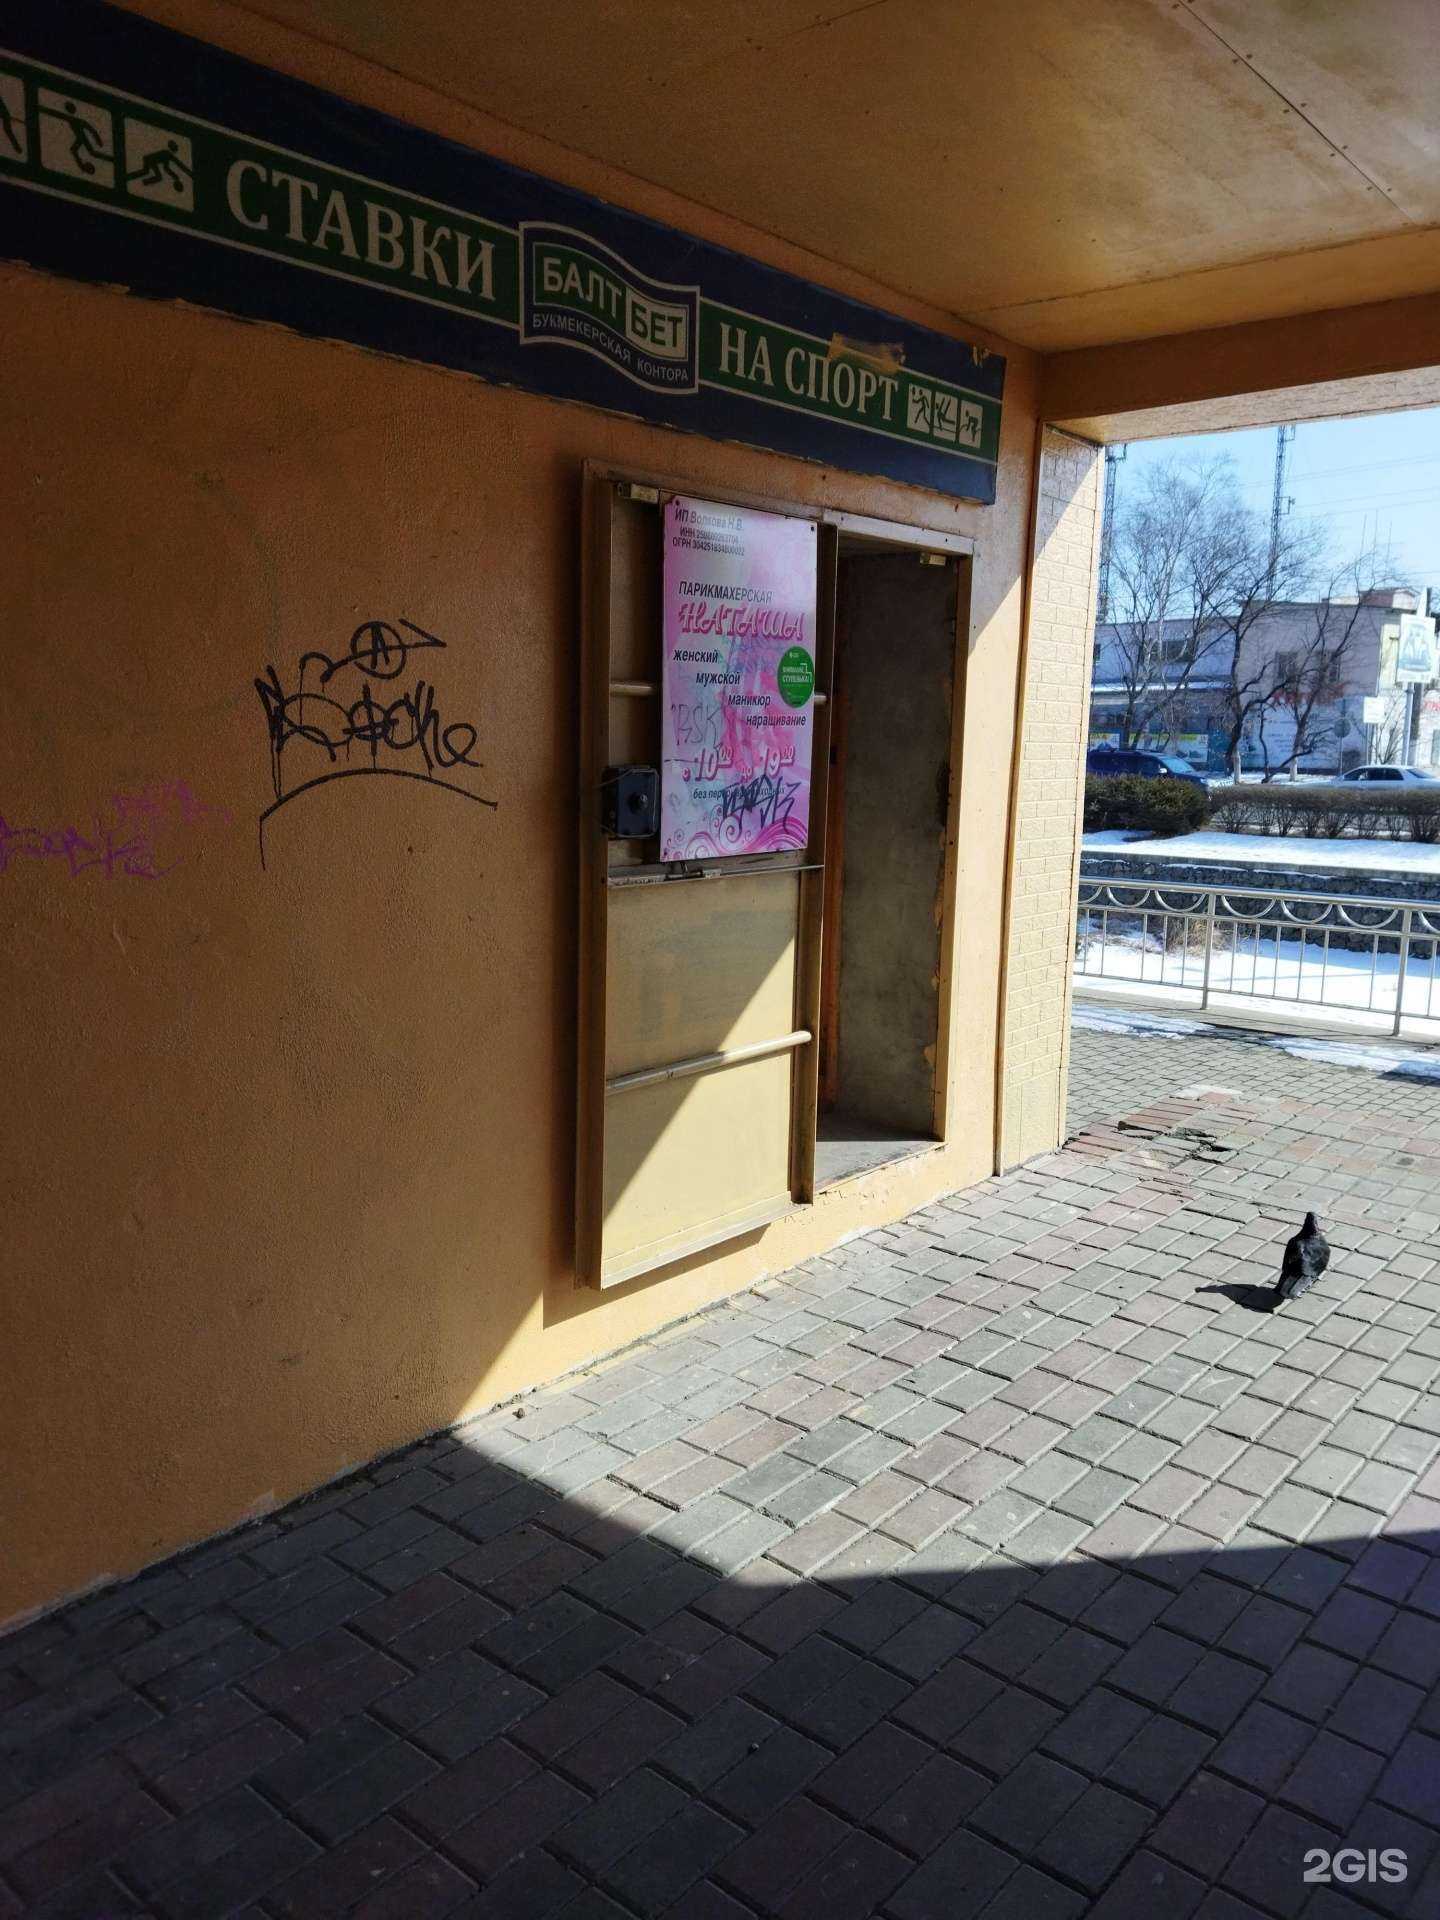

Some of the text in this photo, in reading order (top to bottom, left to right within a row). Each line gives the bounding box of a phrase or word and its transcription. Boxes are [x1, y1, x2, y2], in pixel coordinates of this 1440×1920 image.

[226, 160, 899, 422] СТАВКИ НА СПОРТ
[532, 313, 689, 382] БУКМЕКЕРСКАЯ КОНТОРА
[674, 508, 689, 522] ИП
[672, 536, 691, 549] ОГРН
[678, 581, 773, 604] ПАРИКМАХЕРСКАЯ
[678, 601, 806, 642] НАТАША
[673, 650, 719, 664] женский
[696, 671, 741, 688] мужской
[728, 694, 771, 709] маникюр
[746, 714, 807, 729] наращивание
[693, 787, 707, 800] без
